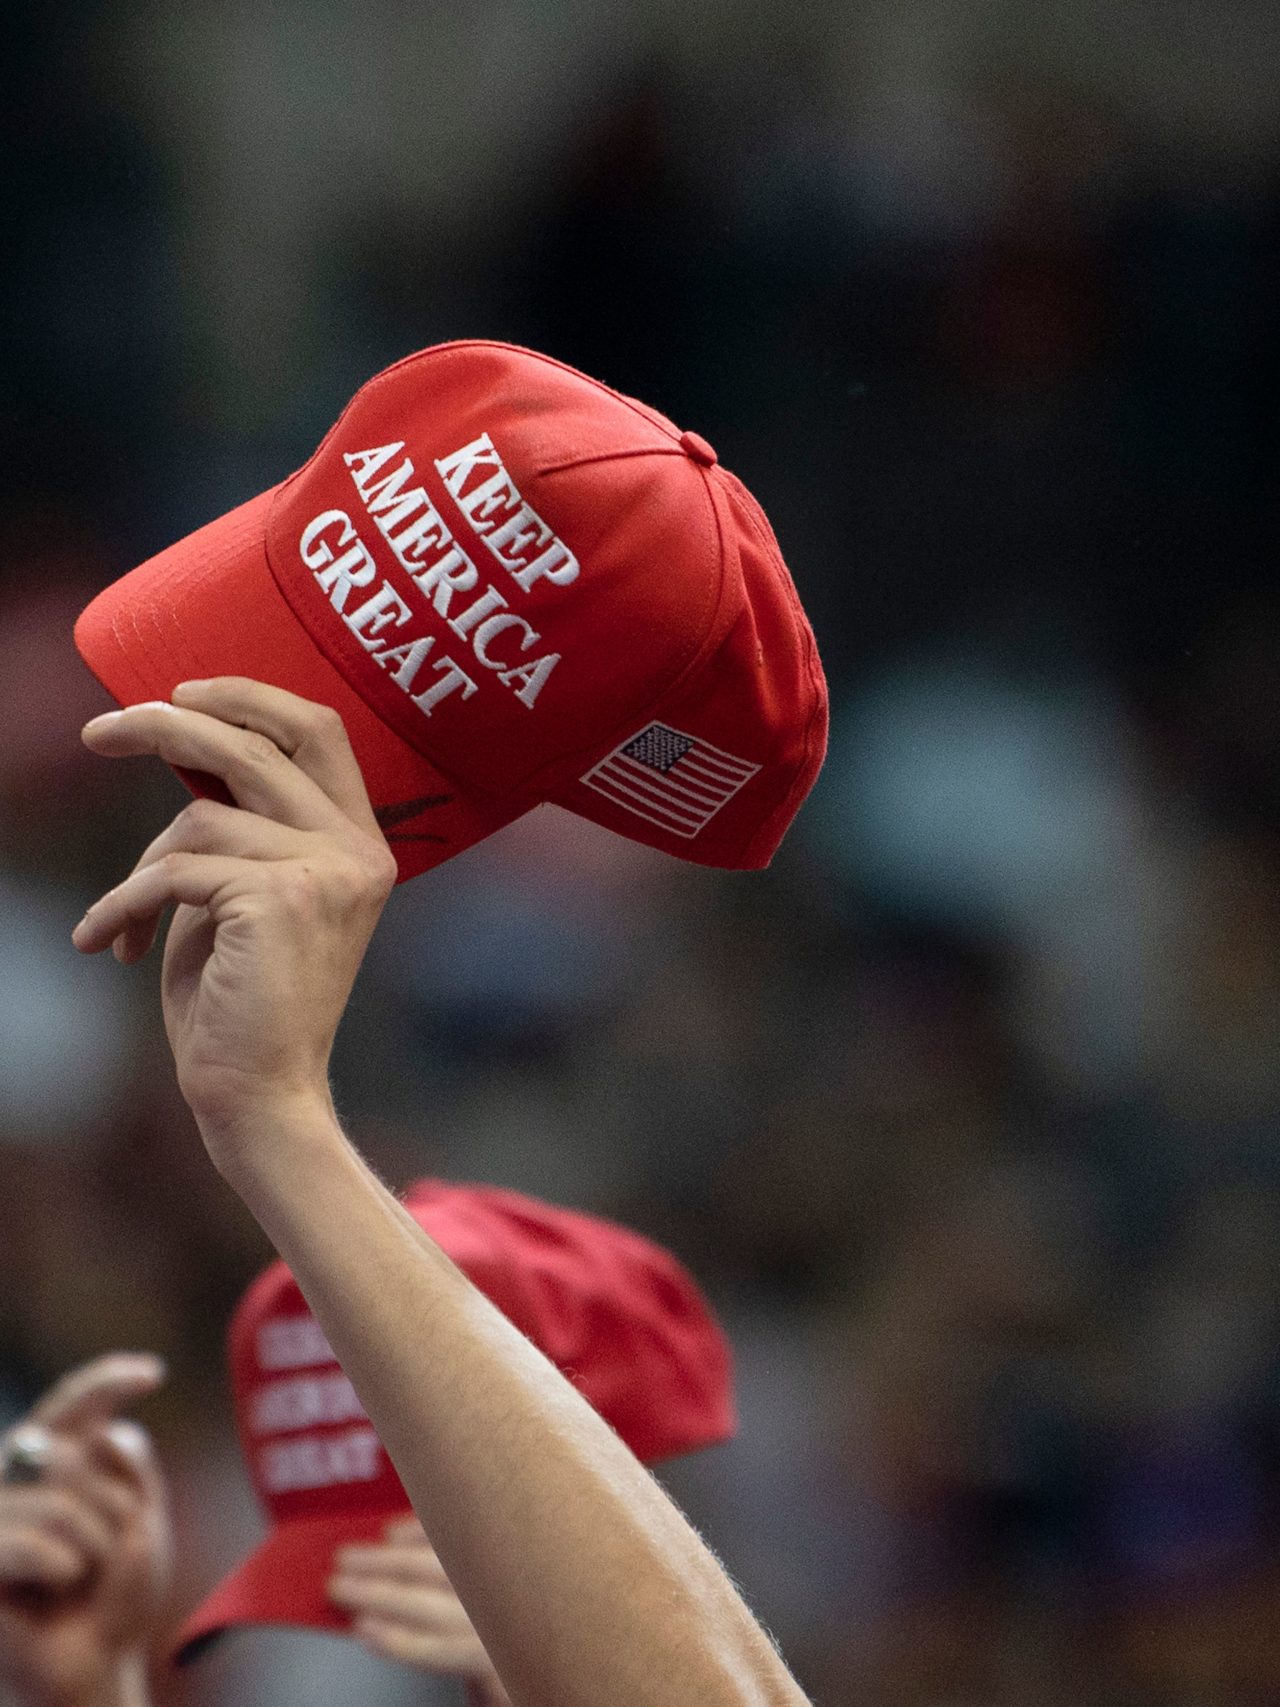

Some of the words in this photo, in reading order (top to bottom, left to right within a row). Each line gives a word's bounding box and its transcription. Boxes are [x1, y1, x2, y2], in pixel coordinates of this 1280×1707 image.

[299, 509, 478, 718] GREAT
[343, 441, 562, 710] AMERICA
[434, 432, 580, 594] KEEP
